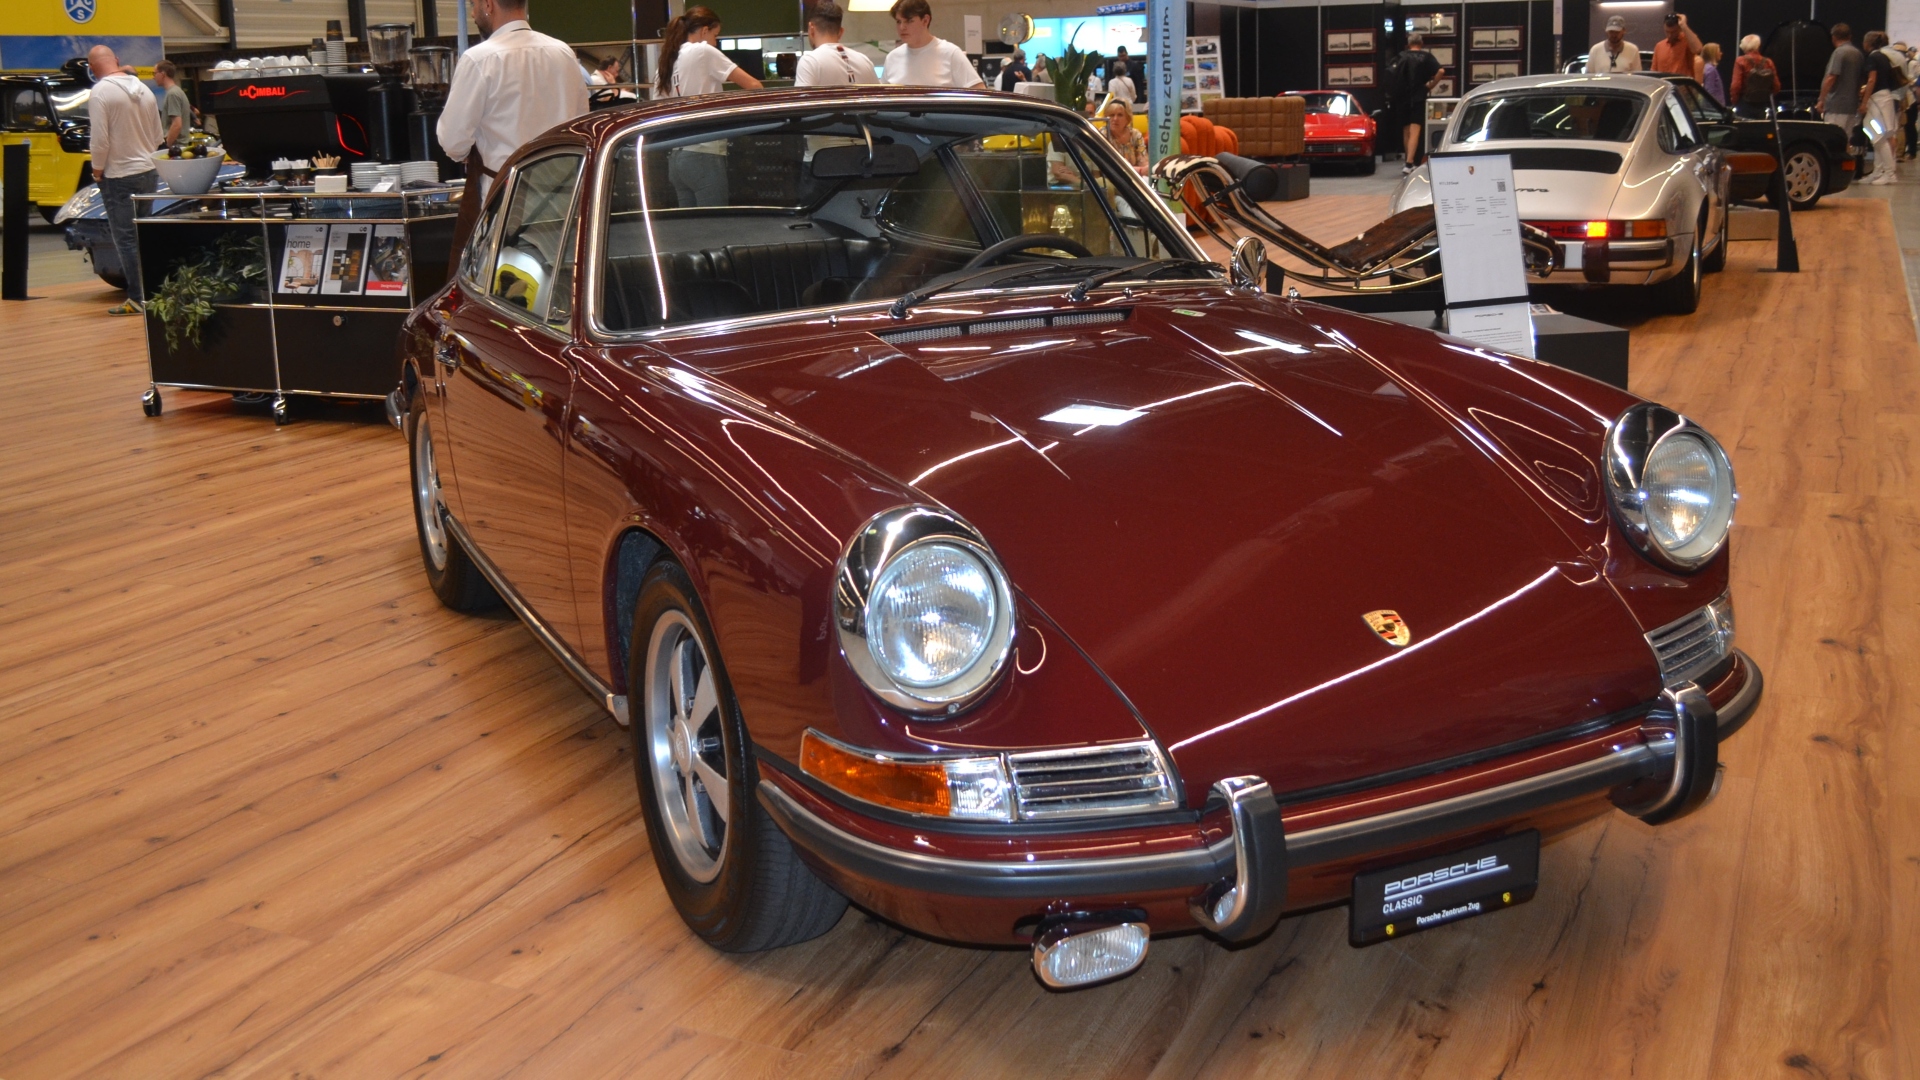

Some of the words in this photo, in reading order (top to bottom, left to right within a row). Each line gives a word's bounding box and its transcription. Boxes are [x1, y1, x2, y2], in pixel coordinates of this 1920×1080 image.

[1162, 6, 1173, 99] zentrum
[1159, 105, 1172, 155] sche
[287, 239, 311, 249] home
[1384, 855, 1497, 895] PORSCHE
[1382, 894, 1423, 914] CLASSIC
[1416, 912, 1441, 925] Porsche
[1441, 905, 1467, 918] Zentrum
[1467, 901, 1480, 911] Zug
